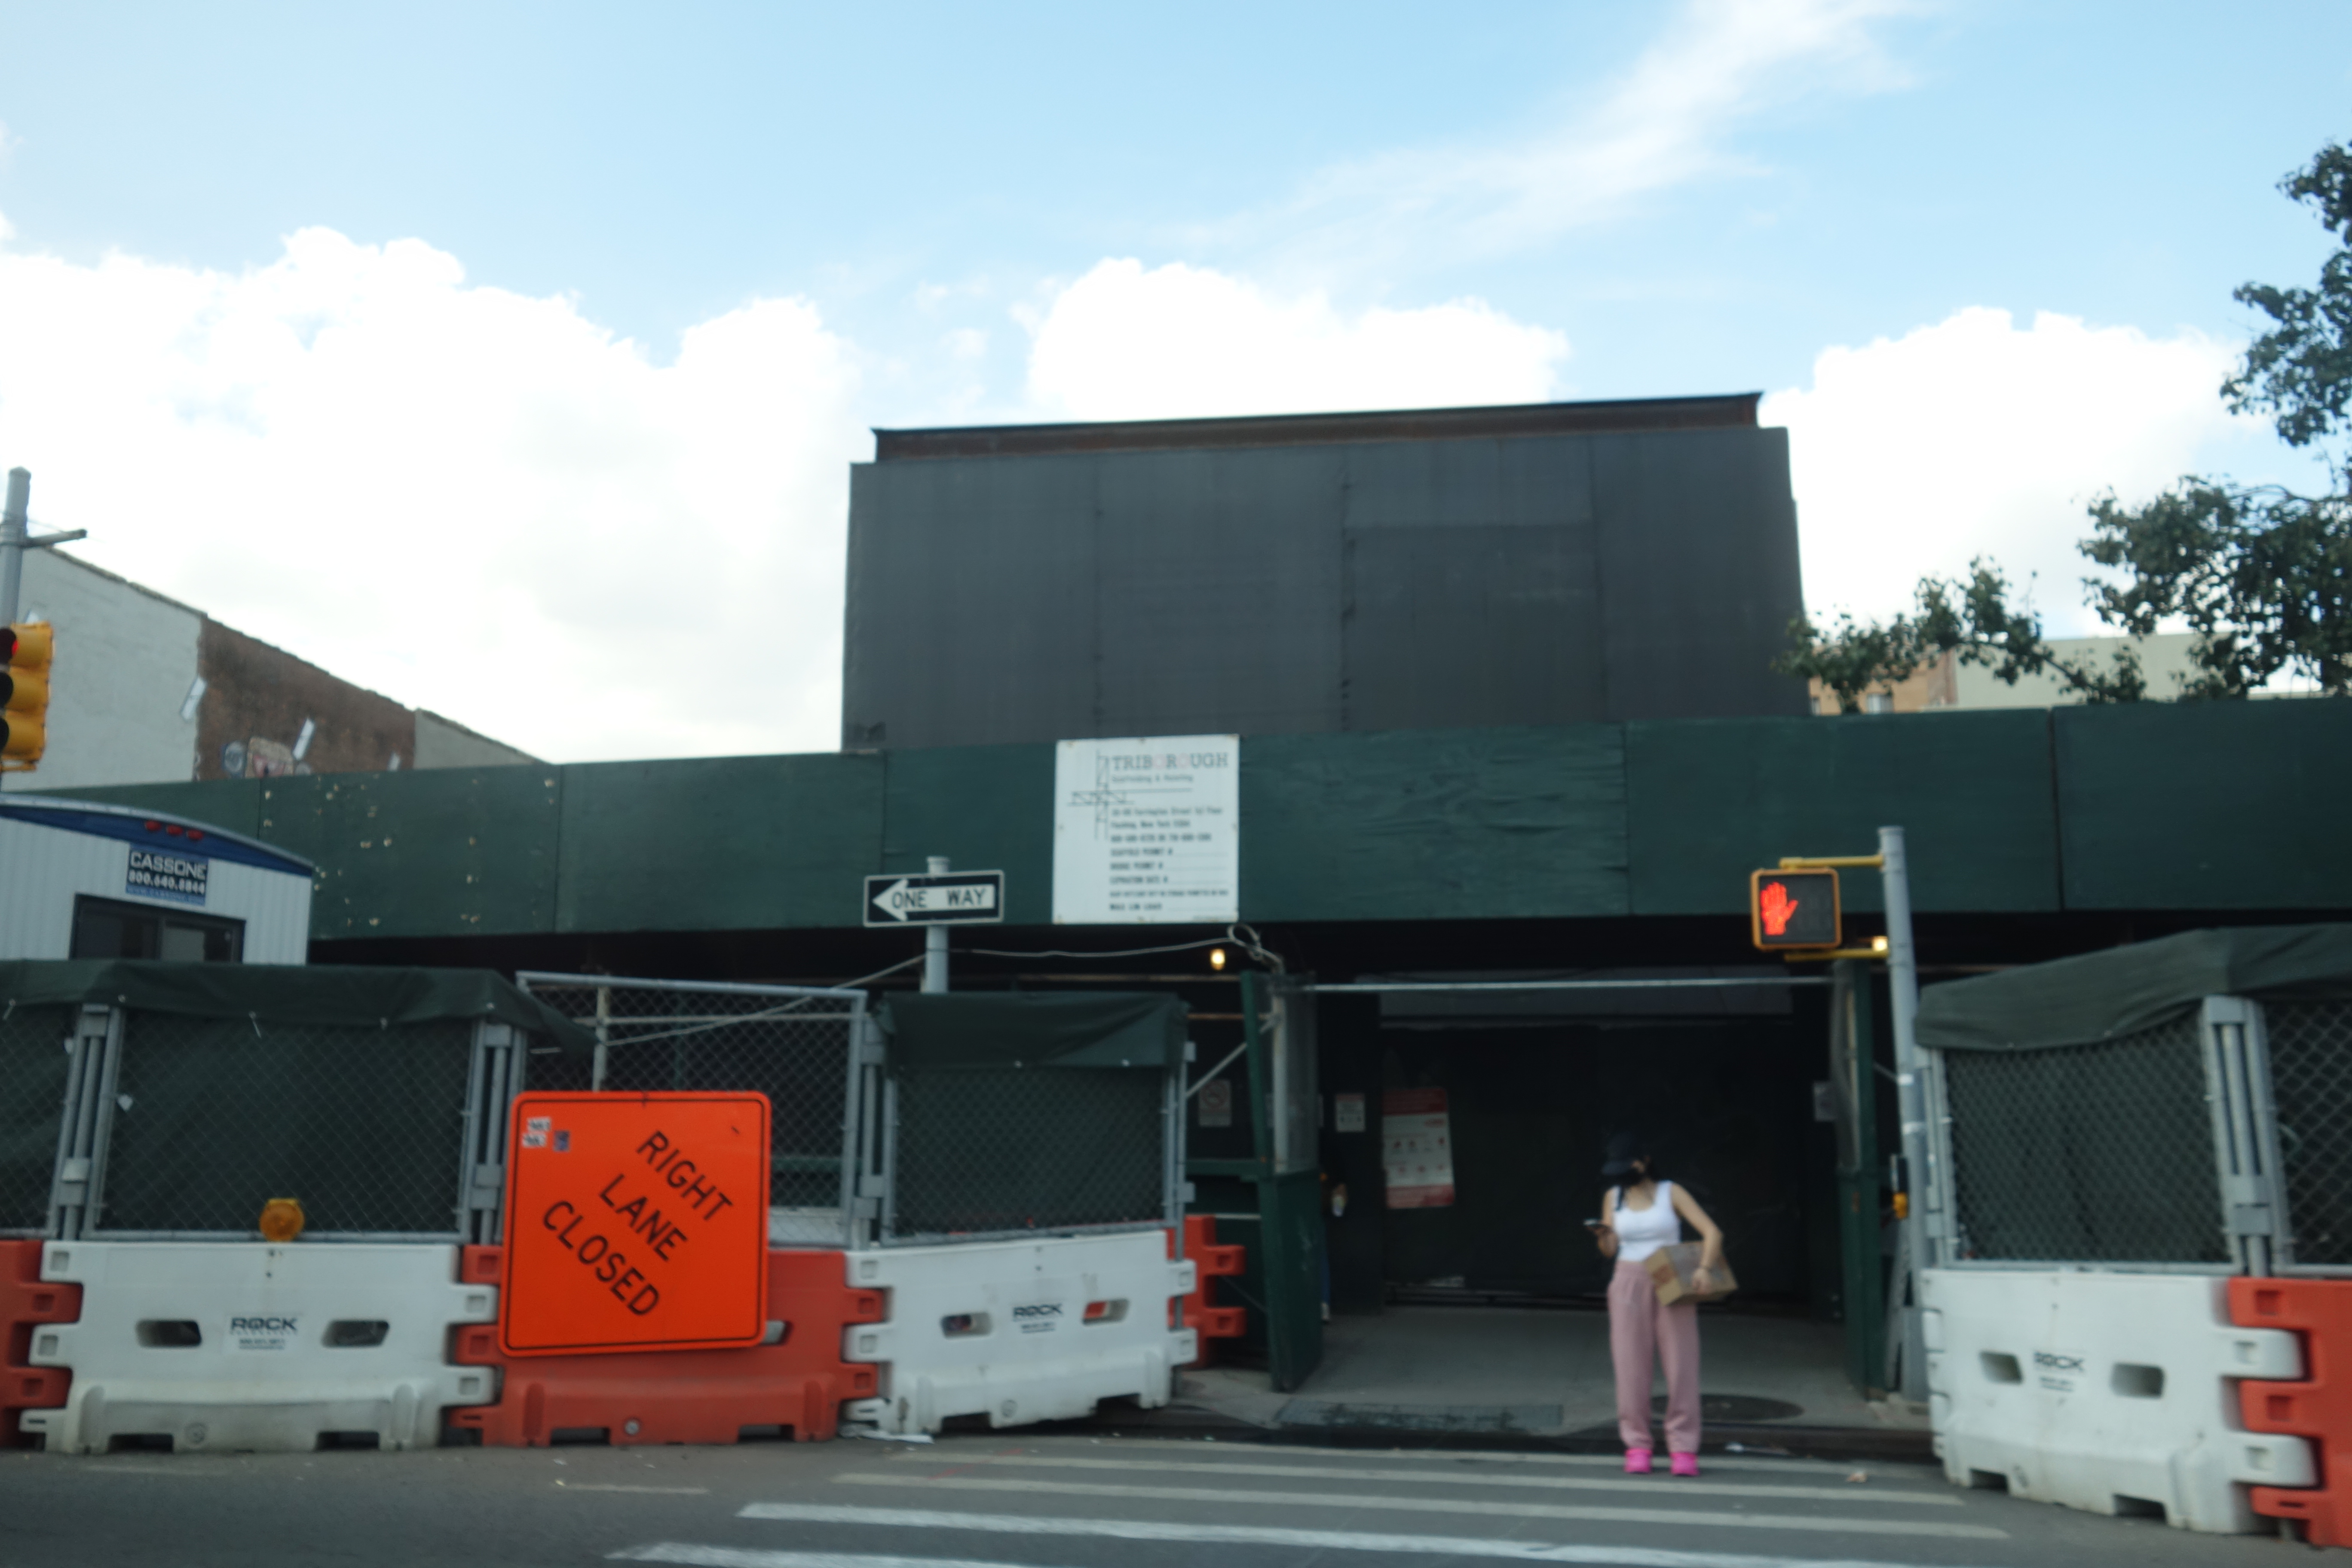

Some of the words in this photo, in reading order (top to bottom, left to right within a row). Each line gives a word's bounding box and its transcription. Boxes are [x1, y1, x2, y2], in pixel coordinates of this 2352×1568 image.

[1111, 752, 1228, 771] TRIBOROUGH
[131, 852, 207, 880] CASSONE
[892, 890, 928, 909] ONE
[947, 888, 986, 906] WAY
[636, 1130, 733, 1221] RIGHT
[598, 1173, 688, 1262] LANE
[542, 1200, 660, 1316] CLOSED
[231, 1317, 297, 1331] ROCK
